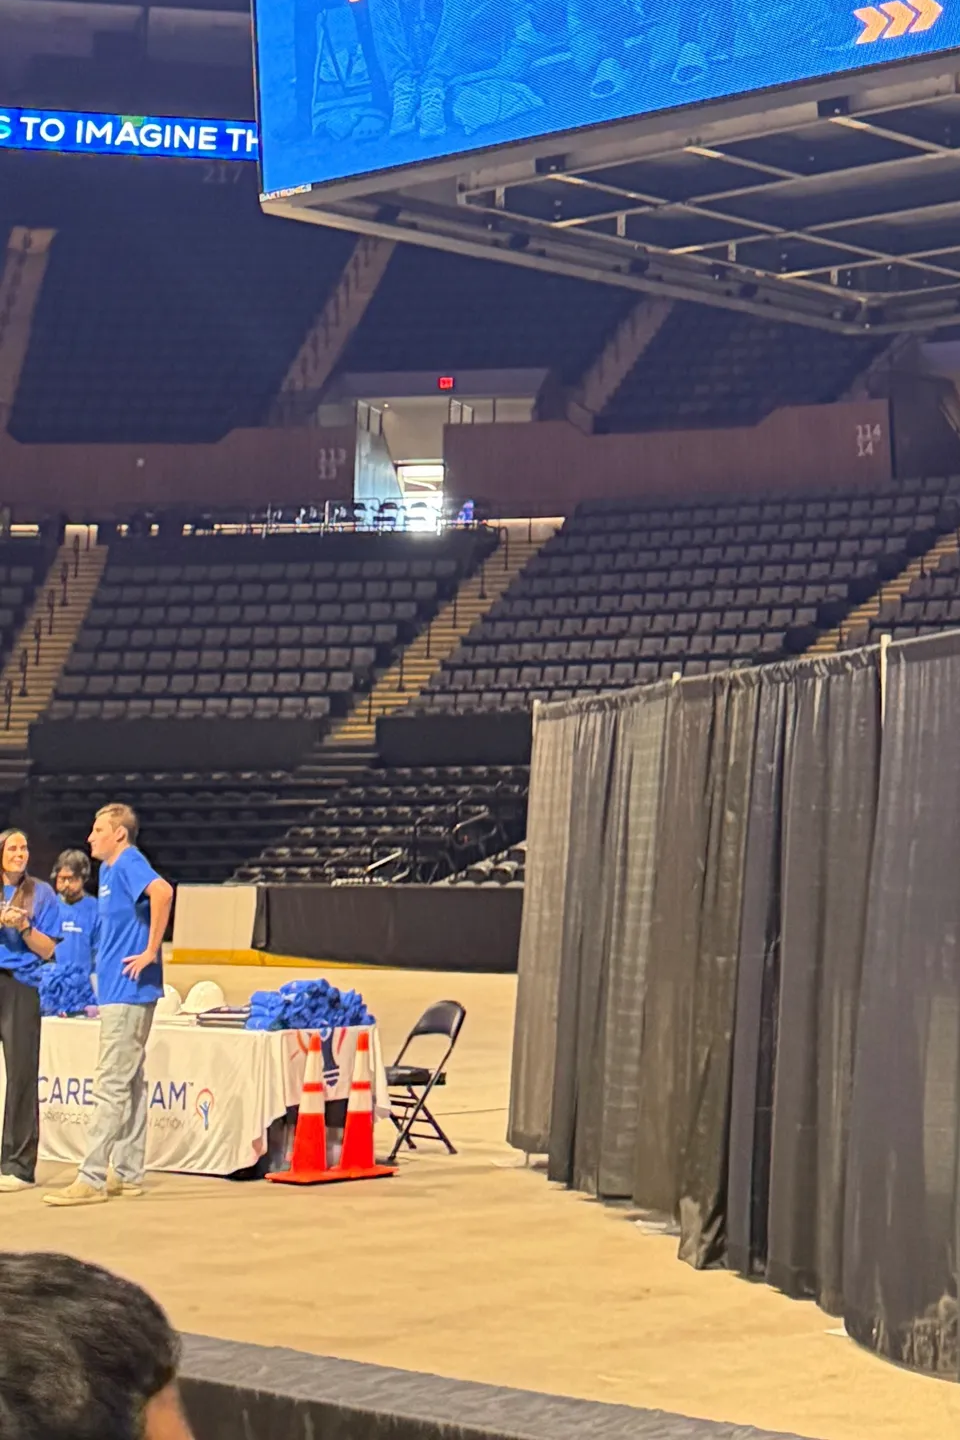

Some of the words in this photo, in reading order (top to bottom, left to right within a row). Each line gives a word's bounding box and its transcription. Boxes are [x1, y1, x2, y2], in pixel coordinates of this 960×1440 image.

[20, 117, 66, 142] TO
[76, 120, 218, 150] IMAGINE
[856, 423, 881, 439] 114
[37, 1076, 98, 1107] CARE
